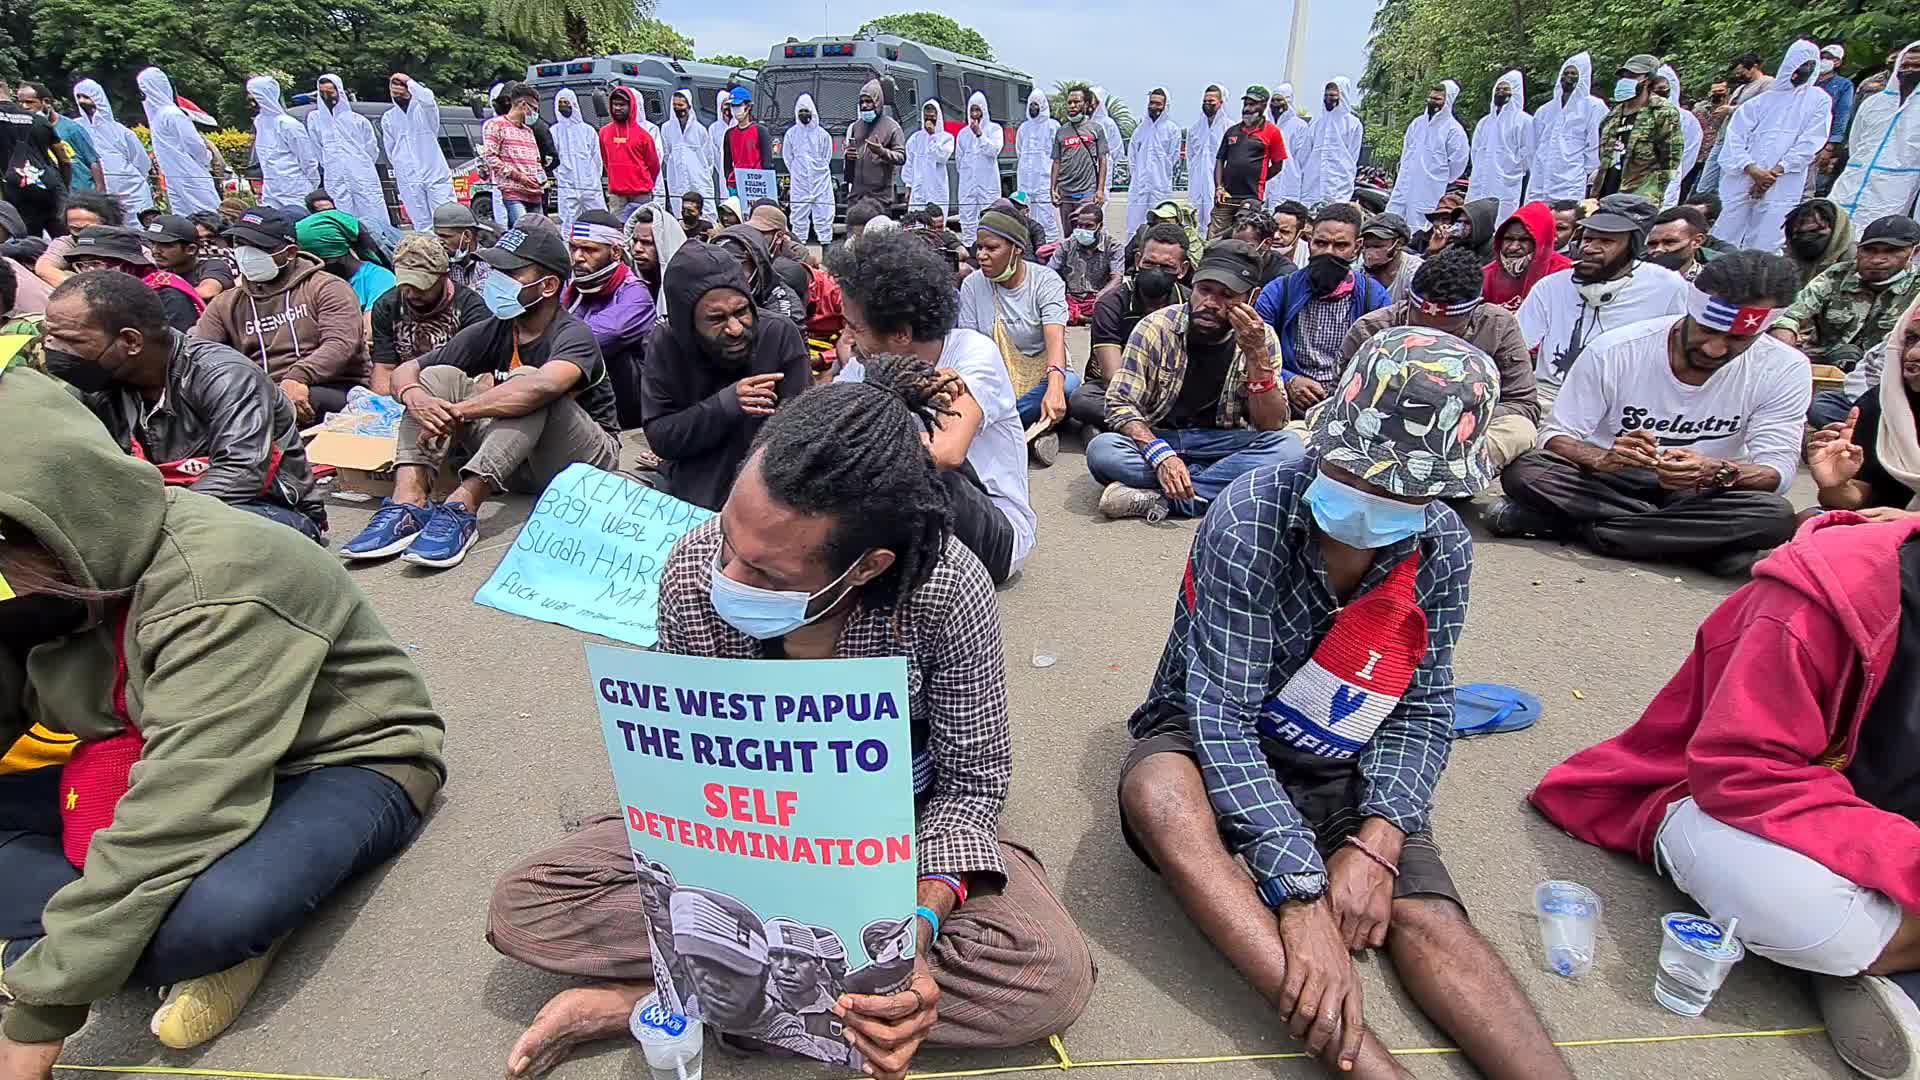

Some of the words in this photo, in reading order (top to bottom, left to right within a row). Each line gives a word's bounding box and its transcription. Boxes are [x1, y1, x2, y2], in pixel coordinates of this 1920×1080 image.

[1621, 405, 1741, 434] Soelastri
[599, 677, 670, 712] GIVE
[675, 688, 766, 722] WEST
[775, 692, 899, 723] PAPUA
[617, 720, 684, 760] THE
[691, 732, 818, 773] RIGHT
[828, 739, 889, 773] TO
[703, 783, 799, 828] SELF
[626, 805, 912, 866] DETERMINATION
